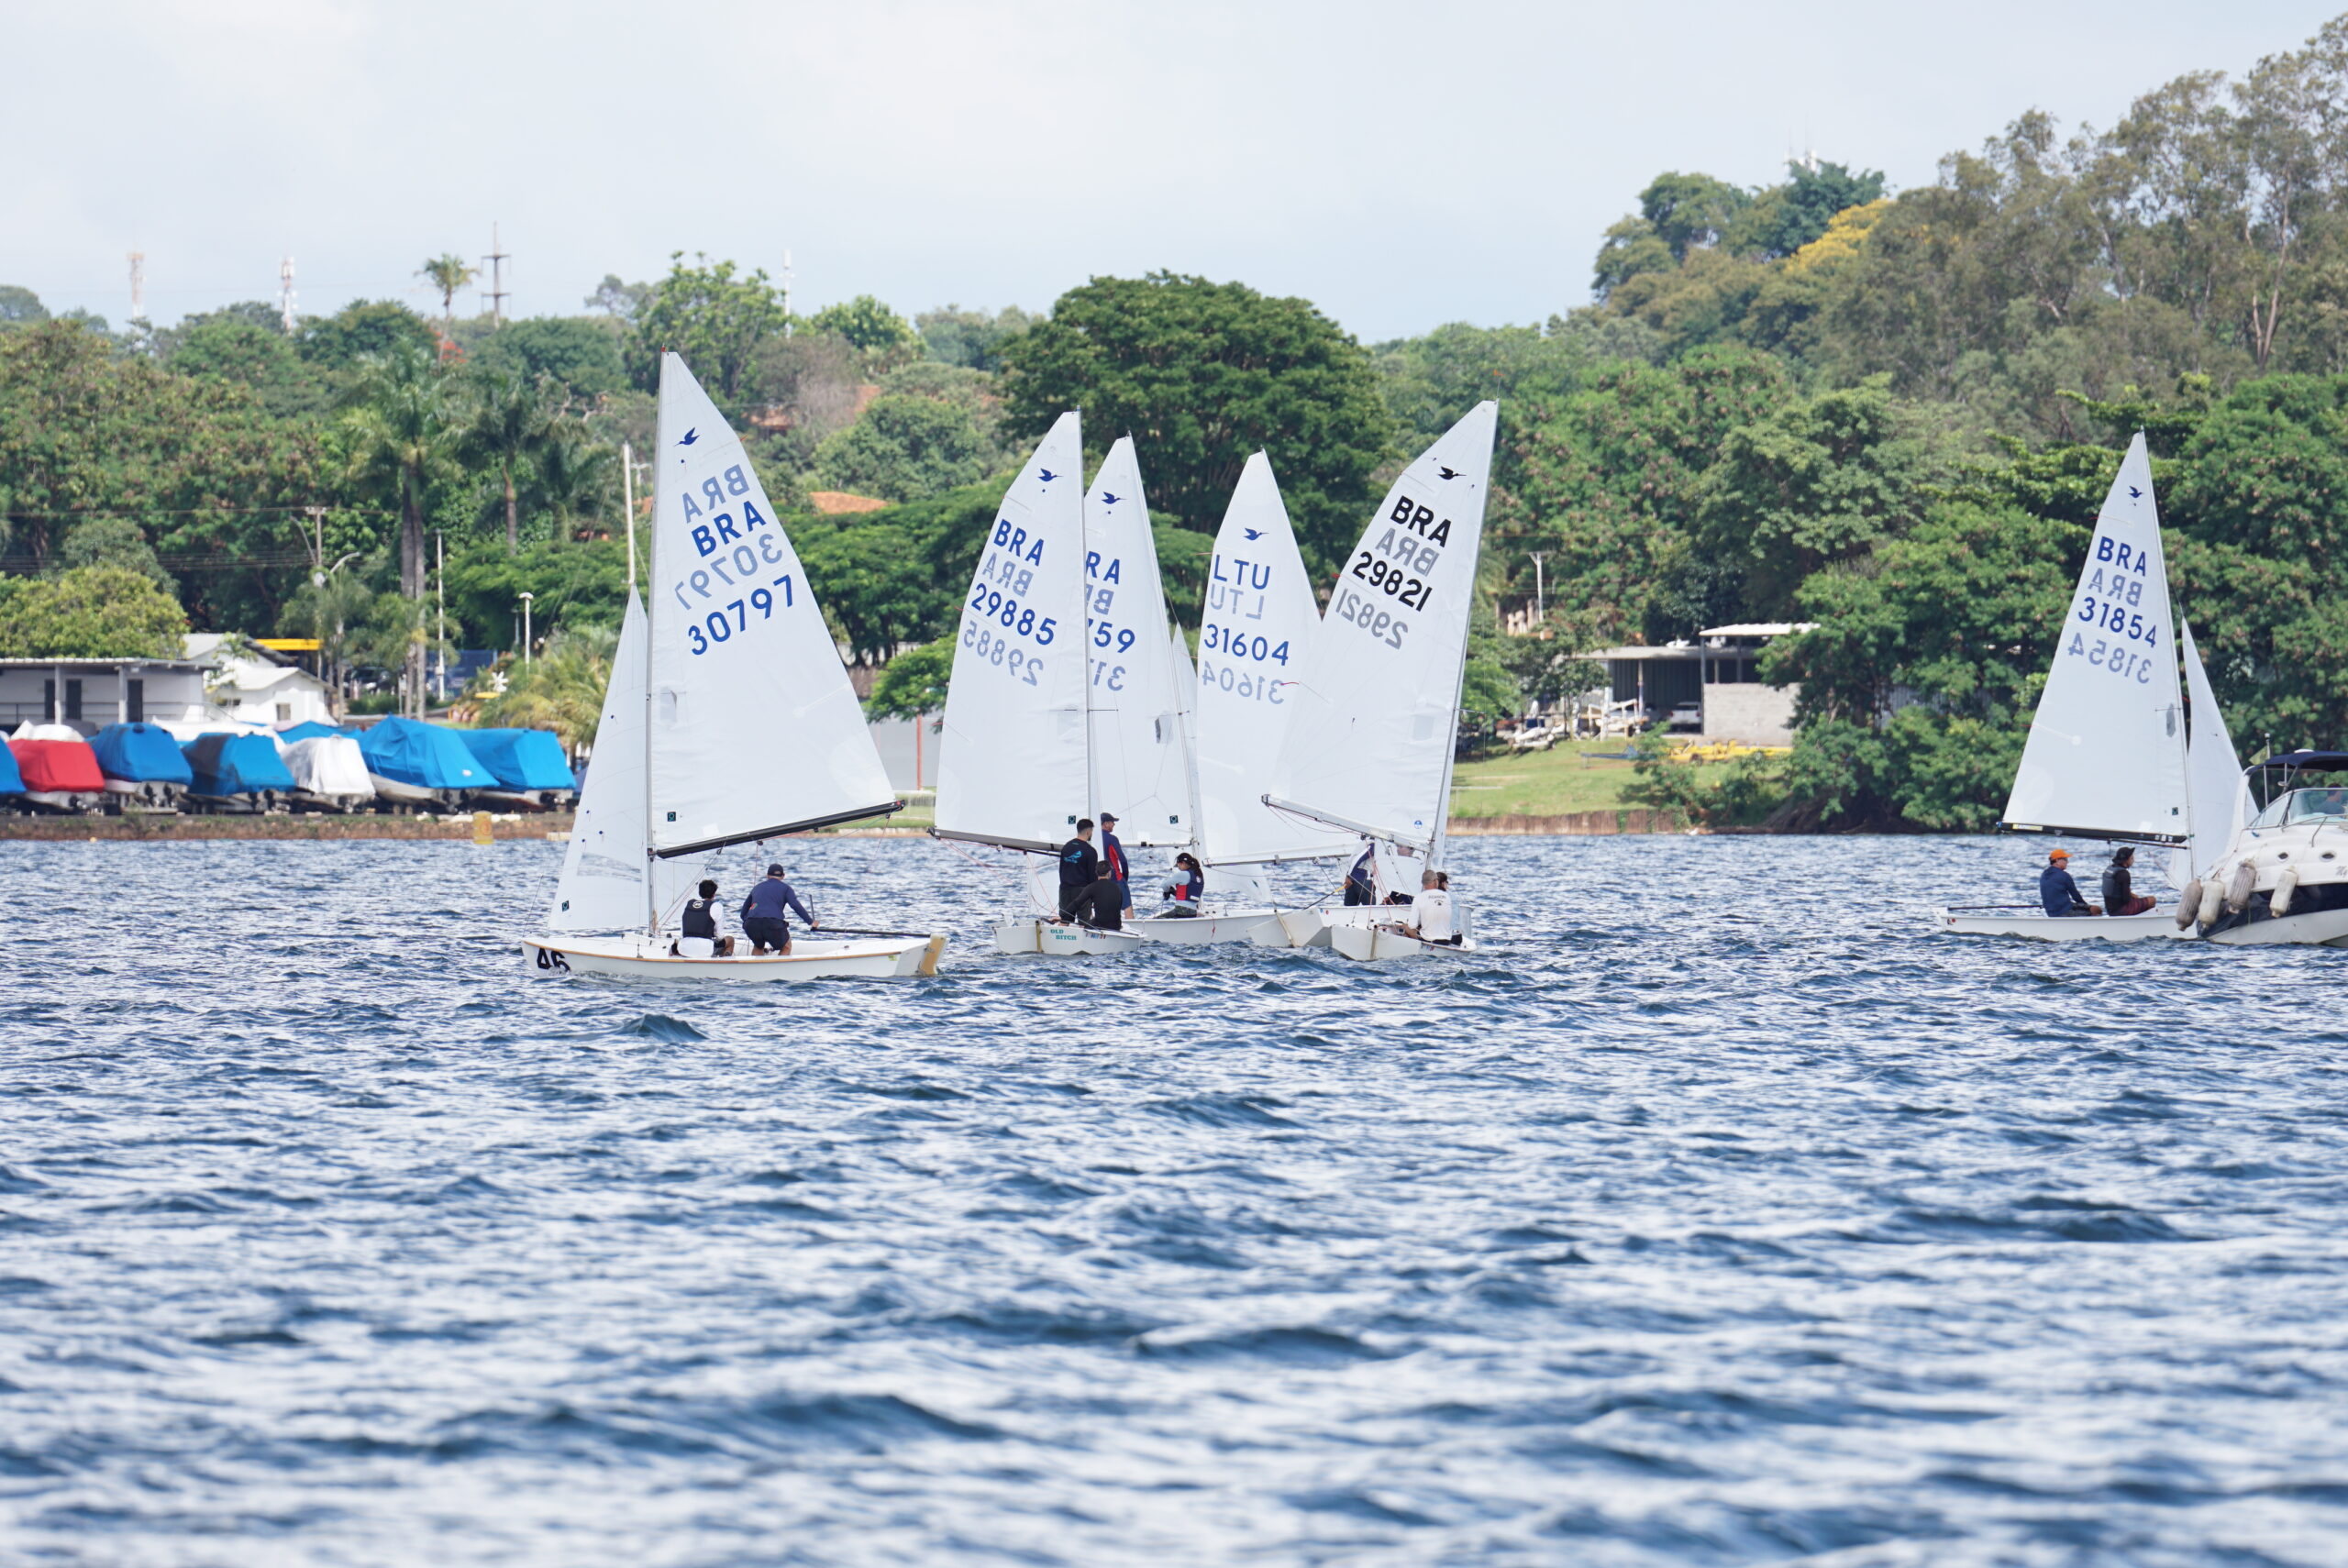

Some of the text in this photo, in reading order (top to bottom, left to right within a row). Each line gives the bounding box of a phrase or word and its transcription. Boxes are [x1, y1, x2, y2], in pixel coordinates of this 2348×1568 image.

[691, 500, 767, 558] BRA
[993, 518, 1045, 567] BRA
[1390, 495, 1452, 548] BRA
[1085, 550, 1120, 585] RA
[1213, 554, 1270, 590] LTU
[2096, 536, 2146, 577] BRA
[1352, 551, 1433, 613] 29821
[688, 574, 793, 656] 30797
[970, 582, 1057, 646] 29885
[1088, 618, 1135, 654] 59
[2078, 597, 2156, 648] 31854
[1203, 624, 1290, 667] 31604
